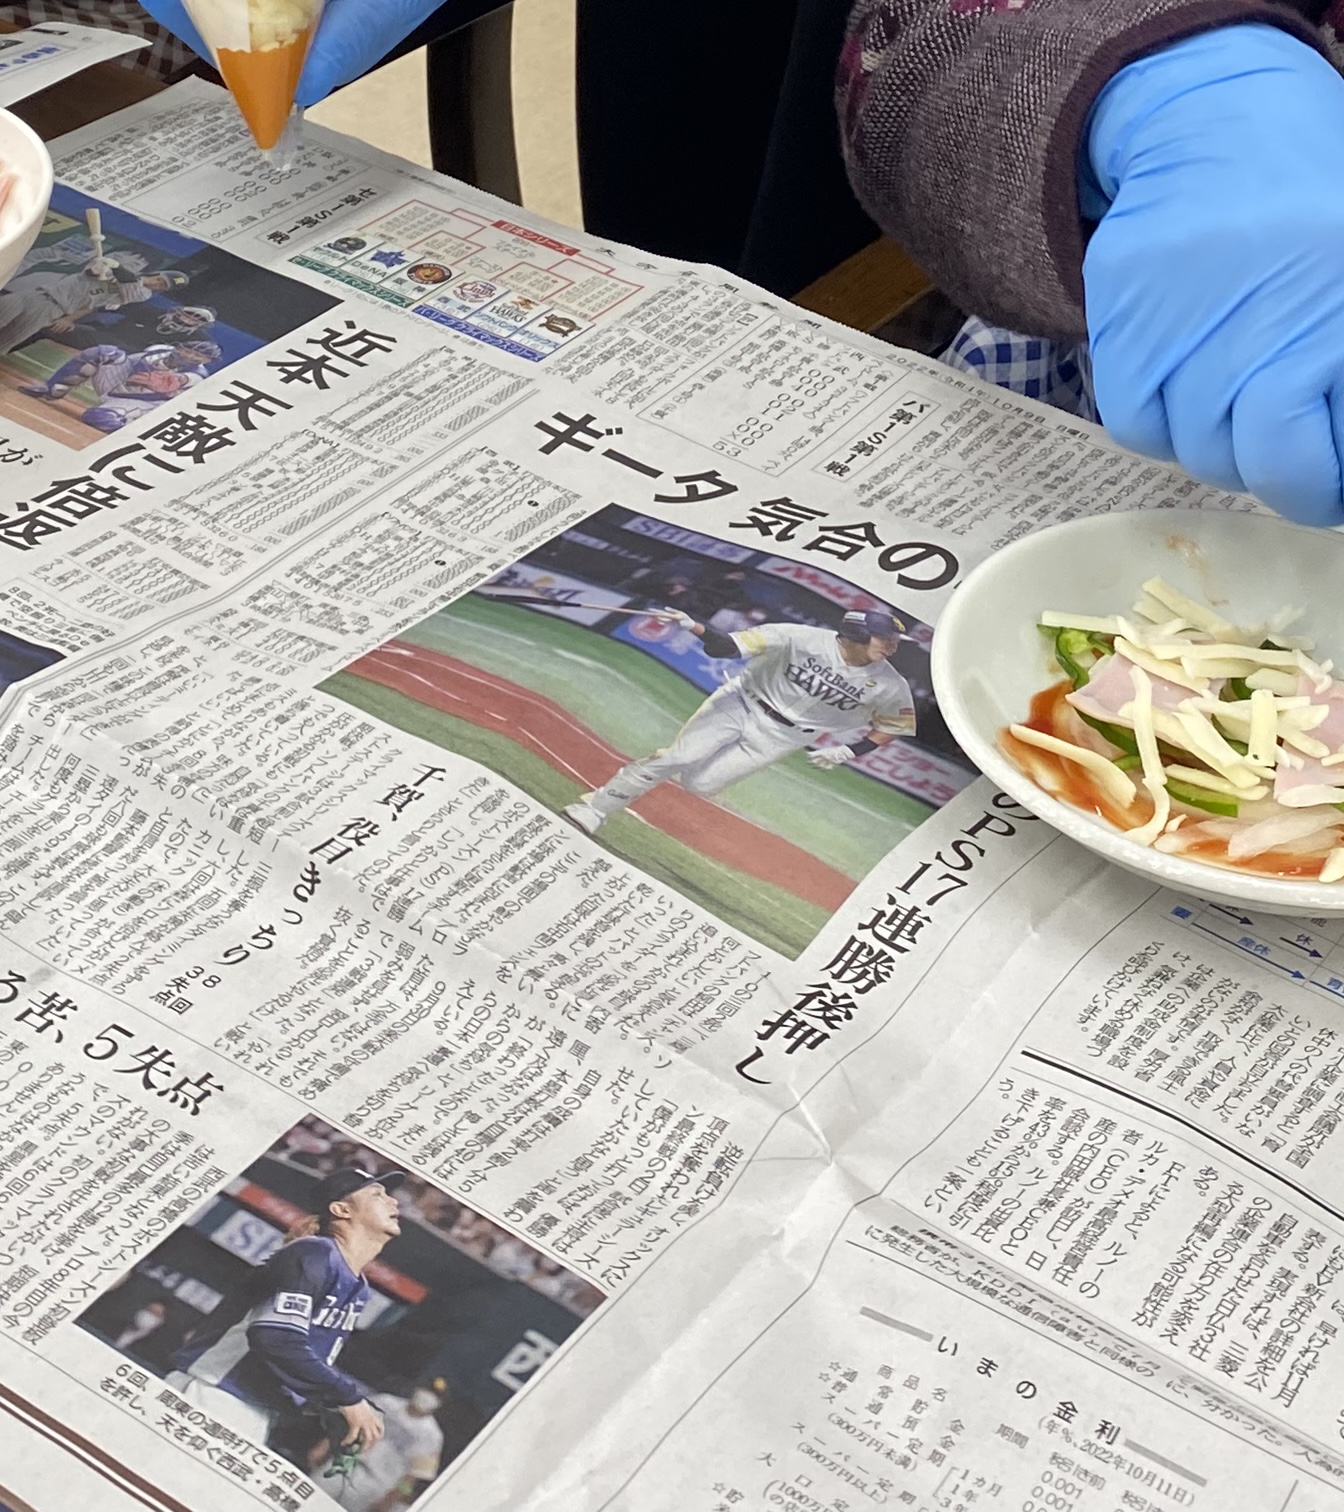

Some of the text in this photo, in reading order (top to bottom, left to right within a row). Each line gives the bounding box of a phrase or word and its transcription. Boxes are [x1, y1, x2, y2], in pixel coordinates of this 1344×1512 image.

[266, 319, 398, 390] 近本
[802, 656, 867, 699] SoftBank
[572, 855, 613, 890] 越えた。
[428, 977, 479, 1037] えている。
[600, 1064, 636, 1105] せた。
[921, 1085, 1042, 1213] き下げることも一案とい
[969, 1104, 1092, 1243] 会談する。ルノーの出資比
[1130, 1179, 1248, 1330] る大型再編になる可能性が
[1157, 1193, 1274, 1347] の企業連合の在り方を変え
[1188, 1211, 1299, 1363] 自動車を合わせた日仏3社
[112, 1362, 315, 1502] 6回、周東の適時打で5点目
[993, 1423, 1031, 1449] 期間
[1038, 1469, 1084, 1501] 0.001
